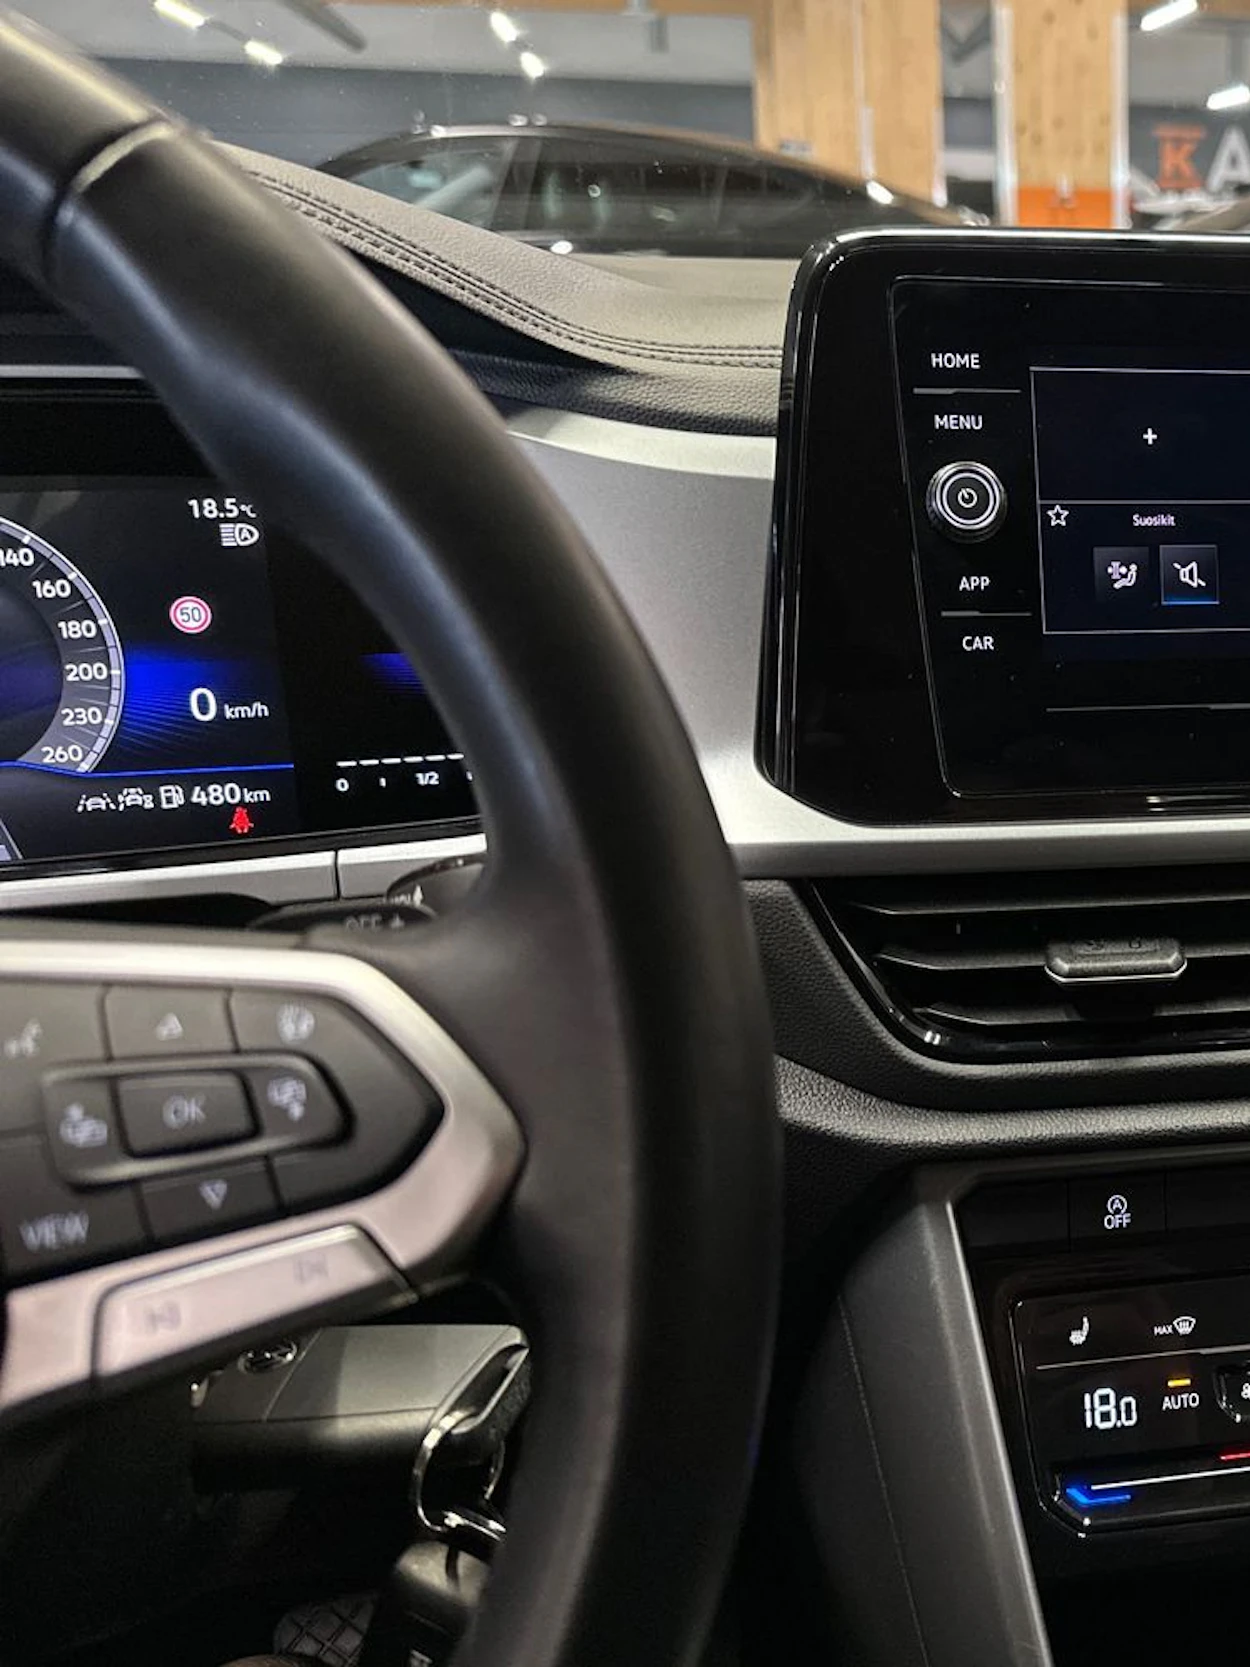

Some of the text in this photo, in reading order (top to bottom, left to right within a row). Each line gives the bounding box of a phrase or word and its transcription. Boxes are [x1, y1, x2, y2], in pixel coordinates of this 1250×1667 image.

[931, 353, 981, 369] HOME
[934, 414, 983, 430] MENU
[188, 497, 257, 519] 18.5°C
[1132, 514, 1177, 527] Suosikit
[0, 548, 35, 567] 140
[32, 579, 72, 599] 160
[958, 576, 991, 591] APP
[180, 606, 202, 623] 50
[57, 619, 98, 639] 180
[962, 636, 995, 651] CAR
[65, 662, 109, 682] 200
[189, 687, 270, 722] 0 km/h
[60, 706, 103, 726] 230
[41, 744, 84, 763] 260
[335, 771, 440, 792] 0 1/2
[162, 1095, 206, 1129] OK
[1103, 1213, 1132, 1230] OFF
[20, 1212, 90, 1252] VIEW
[1153, 1324, 1174, 1337] MAX
[1083, 1386, 1138, 1430] 18.0
[1161, 1392, 1200, 1411] AUTO
